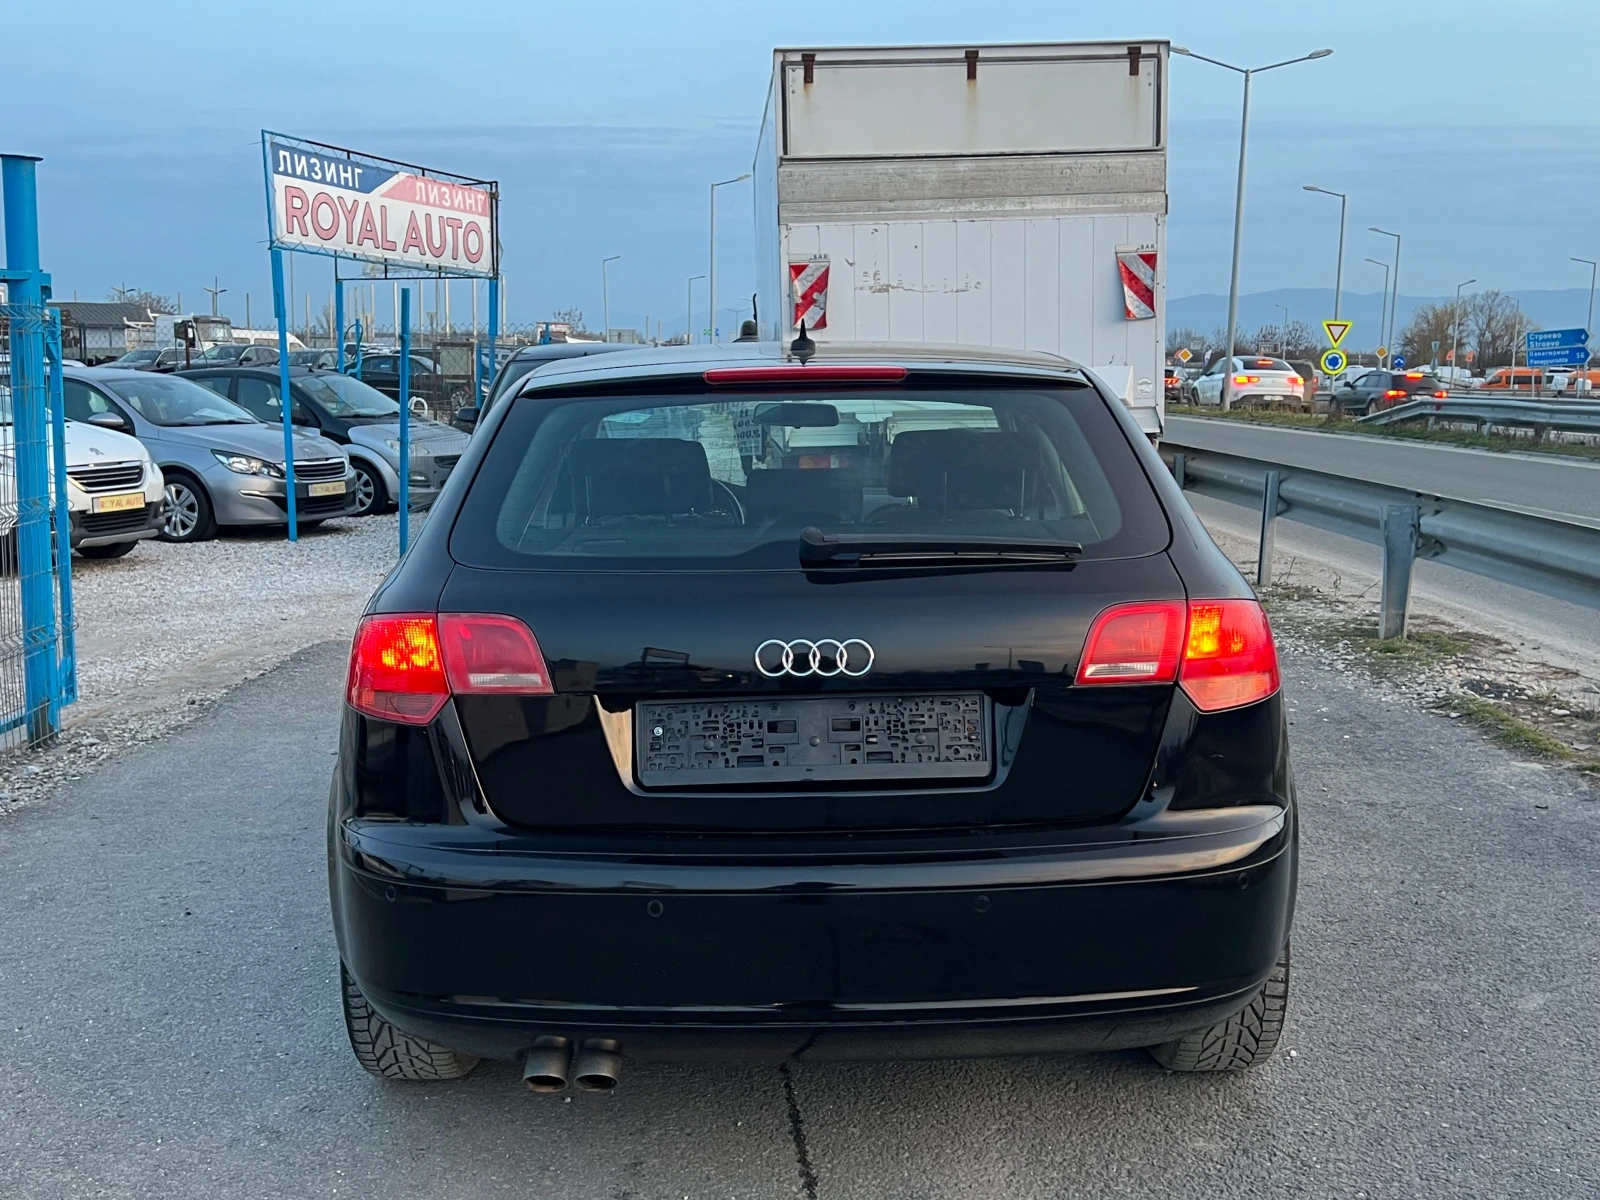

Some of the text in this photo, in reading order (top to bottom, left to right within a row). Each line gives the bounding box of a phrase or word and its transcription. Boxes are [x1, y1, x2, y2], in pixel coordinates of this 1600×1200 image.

[278, 149, 363, 188] ЛИЗИНГ
[415, 182, 485, 213] ЛИЗИНГ
[284, 185, 484, 263] ROYAL AUTO
[1529, 333, 1562, 341] Строево
[1529, 340, 1560, 348] Stroevo
